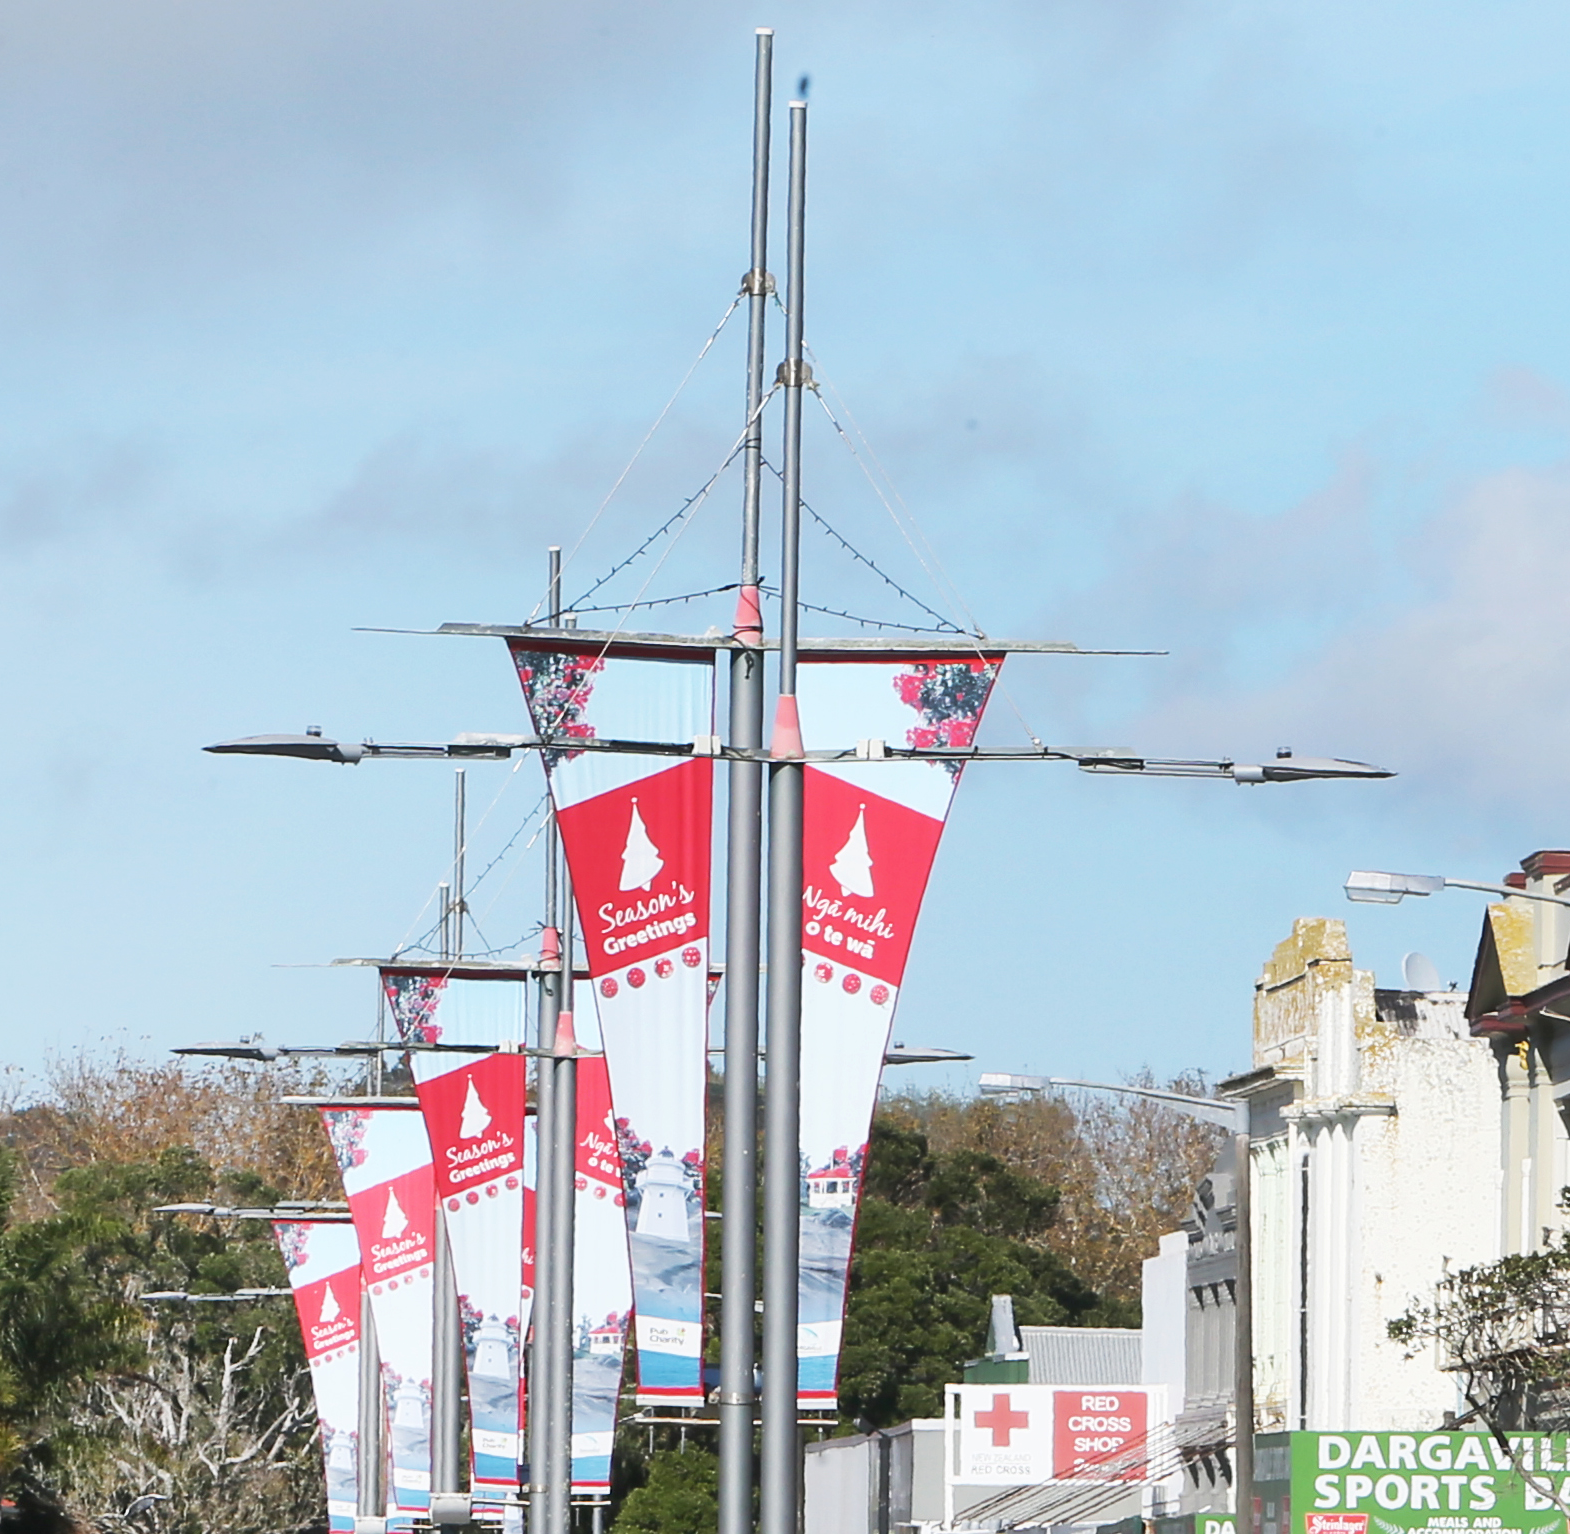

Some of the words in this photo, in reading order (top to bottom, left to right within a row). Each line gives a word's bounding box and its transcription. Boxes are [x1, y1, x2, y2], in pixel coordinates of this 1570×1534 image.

[598, 880, 695, 933] Season's
[603, 911, 697, 955] Greetings
[843, 908, 894, 939] mihi
[824, 921, 842, 946] te
[846, 938, 874, 960] wā
[446, 1131, 514, 1168] Season's
[448, 1152, 516, 1184] Greetings
[370, 1231, 426, 1262] Season's
[373, 1248, 428, 1273] Greetings
[311, 1316, 354, 1341] Season's
[313, 1329, 356, 1350] Greetings
[649, 1327, 669, 1336] Pub
[649, 1335, 684, 1345] Charity
[1081, 1396, 1119, 1411] RED
[1068, 1417, 1132, 1431] CROSS
[1074, 1437, 1124, 1452] SHOP
[971, 1465, 992, 1474] RED
[996, 1466, 1031, 1474] CROSS
[972, 1454, 991, 1462] NEW
[992, 1454, 1031, 1462] ZEALAND
[1313, 1474, 1497, 1511] SPORTS
[1309, 1516, 1364, 1534] Steinlager
[1428, 1517, 1469, 1529] MEALS
[1473, 1517, 1502, 1528] AND
